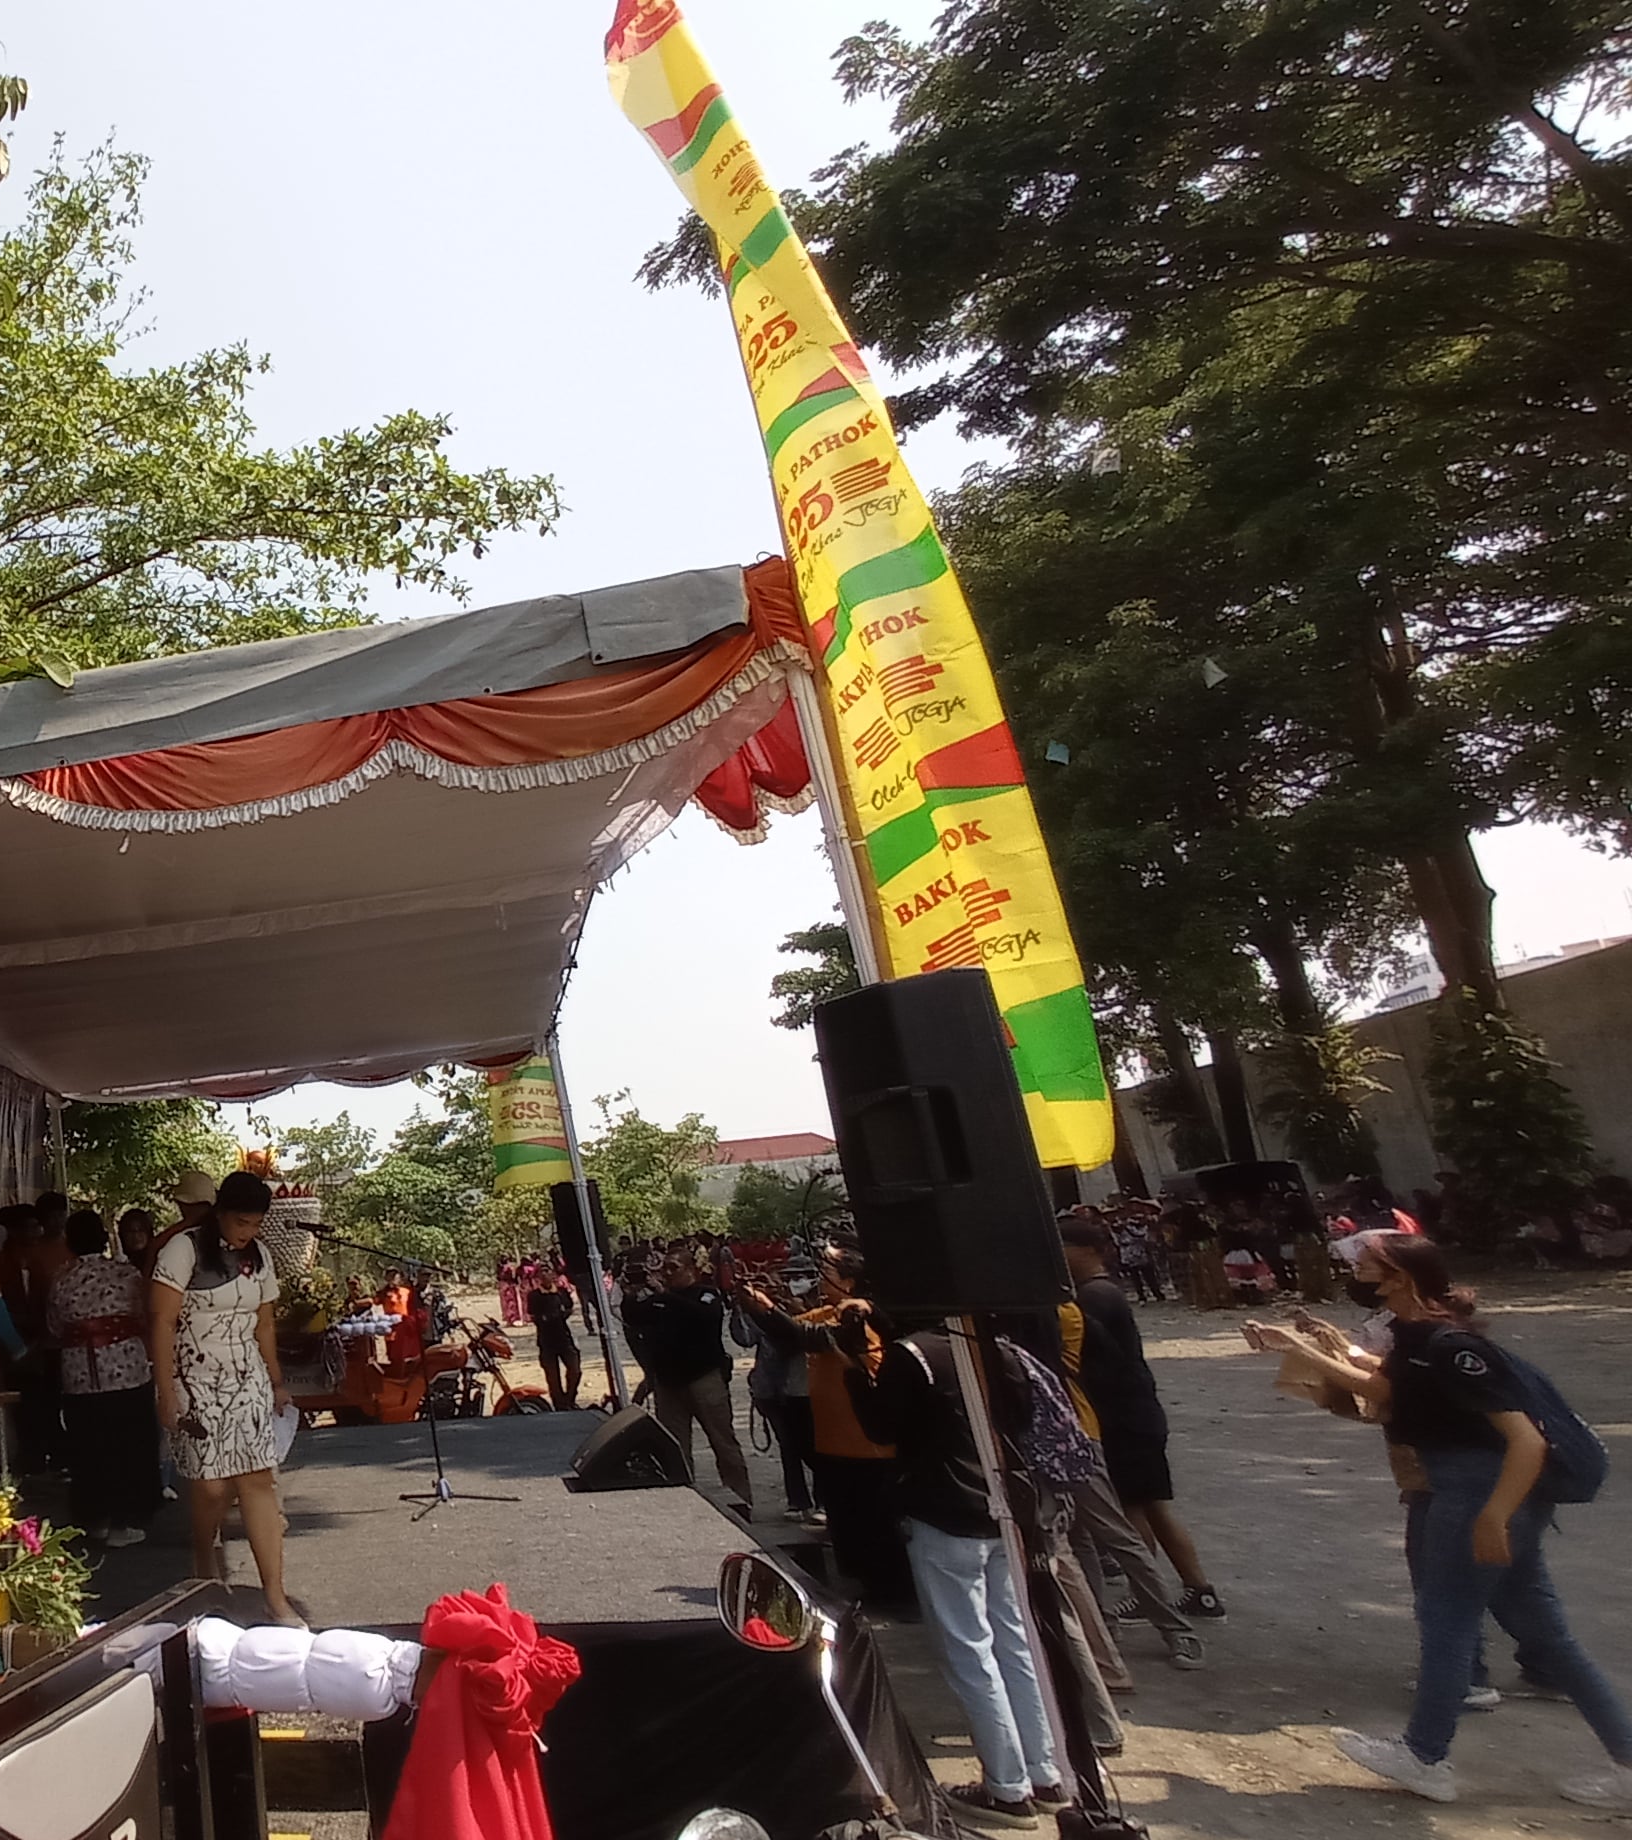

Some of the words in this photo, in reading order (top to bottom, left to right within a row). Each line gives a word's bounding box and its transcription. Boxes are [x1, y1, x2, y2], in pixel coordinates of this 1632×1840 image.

[748, 310, 798, 379] 25
[790, 410, 878, 482] PATHOK
[788, 479, 834, 560] 25
[843, 489, 907, 527] JOGJA
[858, 605, 929, 650] HOK
[895, 696, 967, 736] JOGJA
